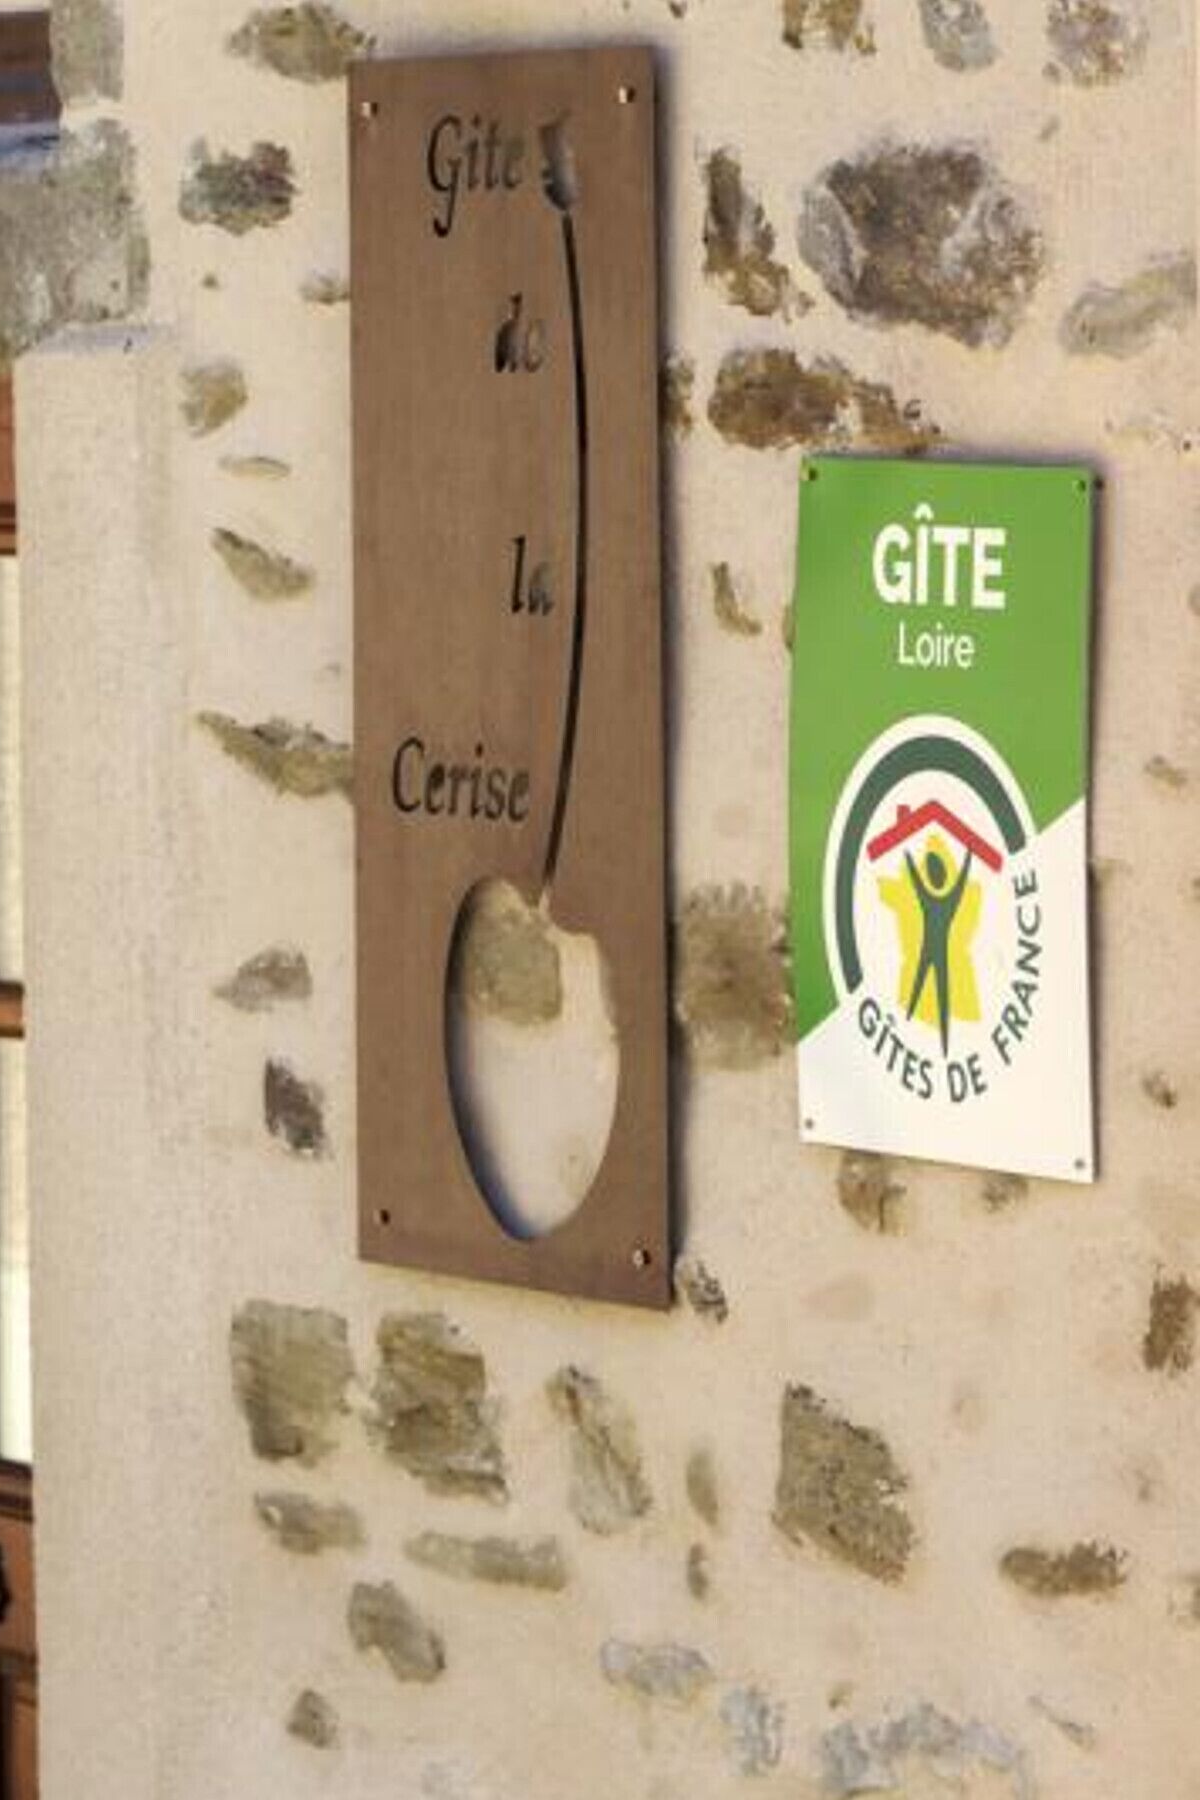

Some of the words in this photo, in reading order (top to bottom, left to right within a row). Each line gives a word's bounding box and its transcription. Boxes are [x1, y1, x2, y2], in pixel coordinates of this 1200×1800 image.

[427, 114, 525, 238] Gite
[494, 291, 545, 374] de
[510, 534, 555, 617] la
[872, 502, 1006, 610] GÎTE
[898, 621, 975, 670] Loire
[392, 736, 530, 823] Cerise
[858, 997, 934, 1101] GÎTES
[947, 1052, 988, 1103] DE
[991, 868, 1043, 1067] FRANCE
